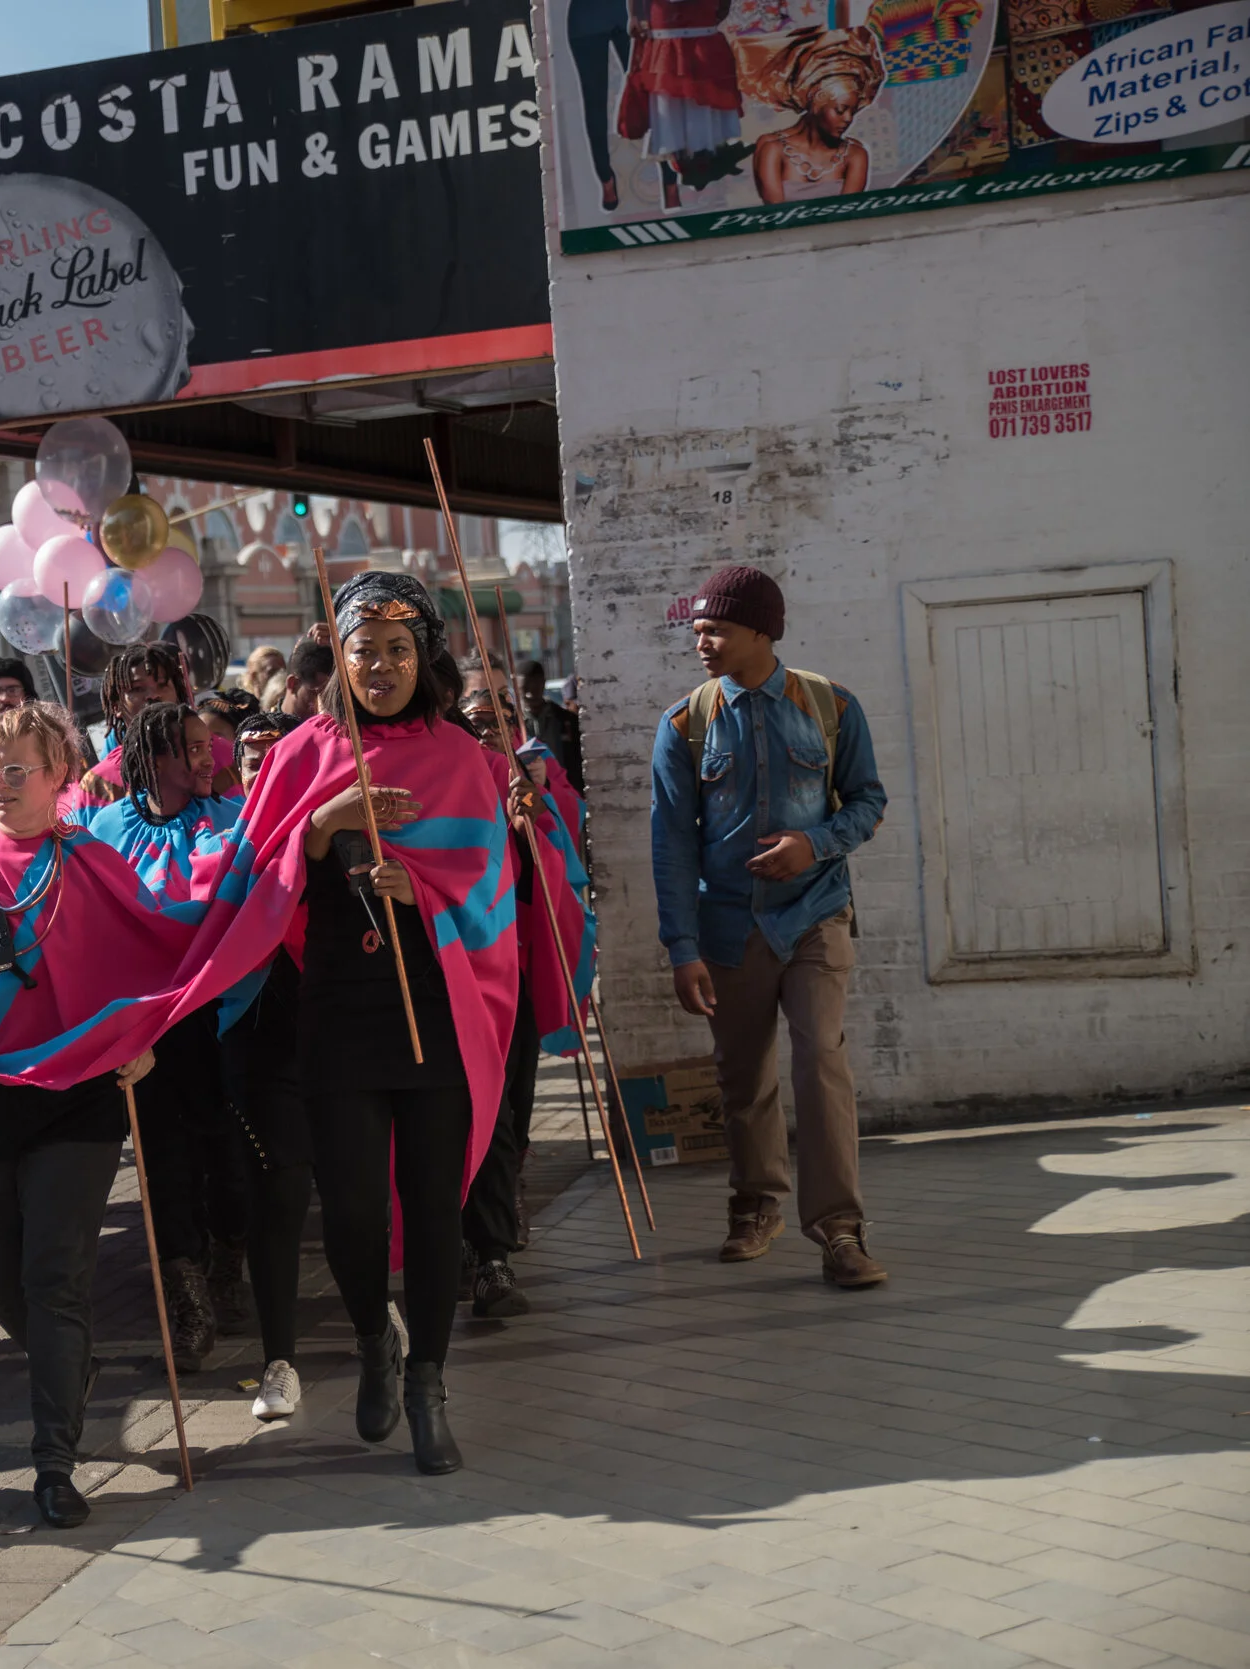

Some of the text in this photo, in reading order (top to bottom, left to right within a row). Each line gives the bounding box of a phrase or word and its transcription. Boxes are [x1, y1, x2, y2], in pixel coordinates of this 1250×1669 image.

[297, 22, 535, 112] RAMA
[1081, 37, 1194, 81] African
[1088, 51, 1240, 106] Material,
[1093, 106, 1159, 138] Zips
[1165, 95, 1187, 117] &
[184, 100, 540, 196] FUN & GAMES
[710, 158, 1187, 231] Professional tailoring!
[51, 238, 149, 309] Label
[0, 318, 110, 375] BEER
[988, 363, 1090, 385] LOST LOVERS
[993, 380, 1087, 400] ABORTION
[989, 394, 1091, 416] PENIS ENLARGEMENT
[989, 411, 1091, 438] 071 739 3517
[711, 490, 732, 505] 18
